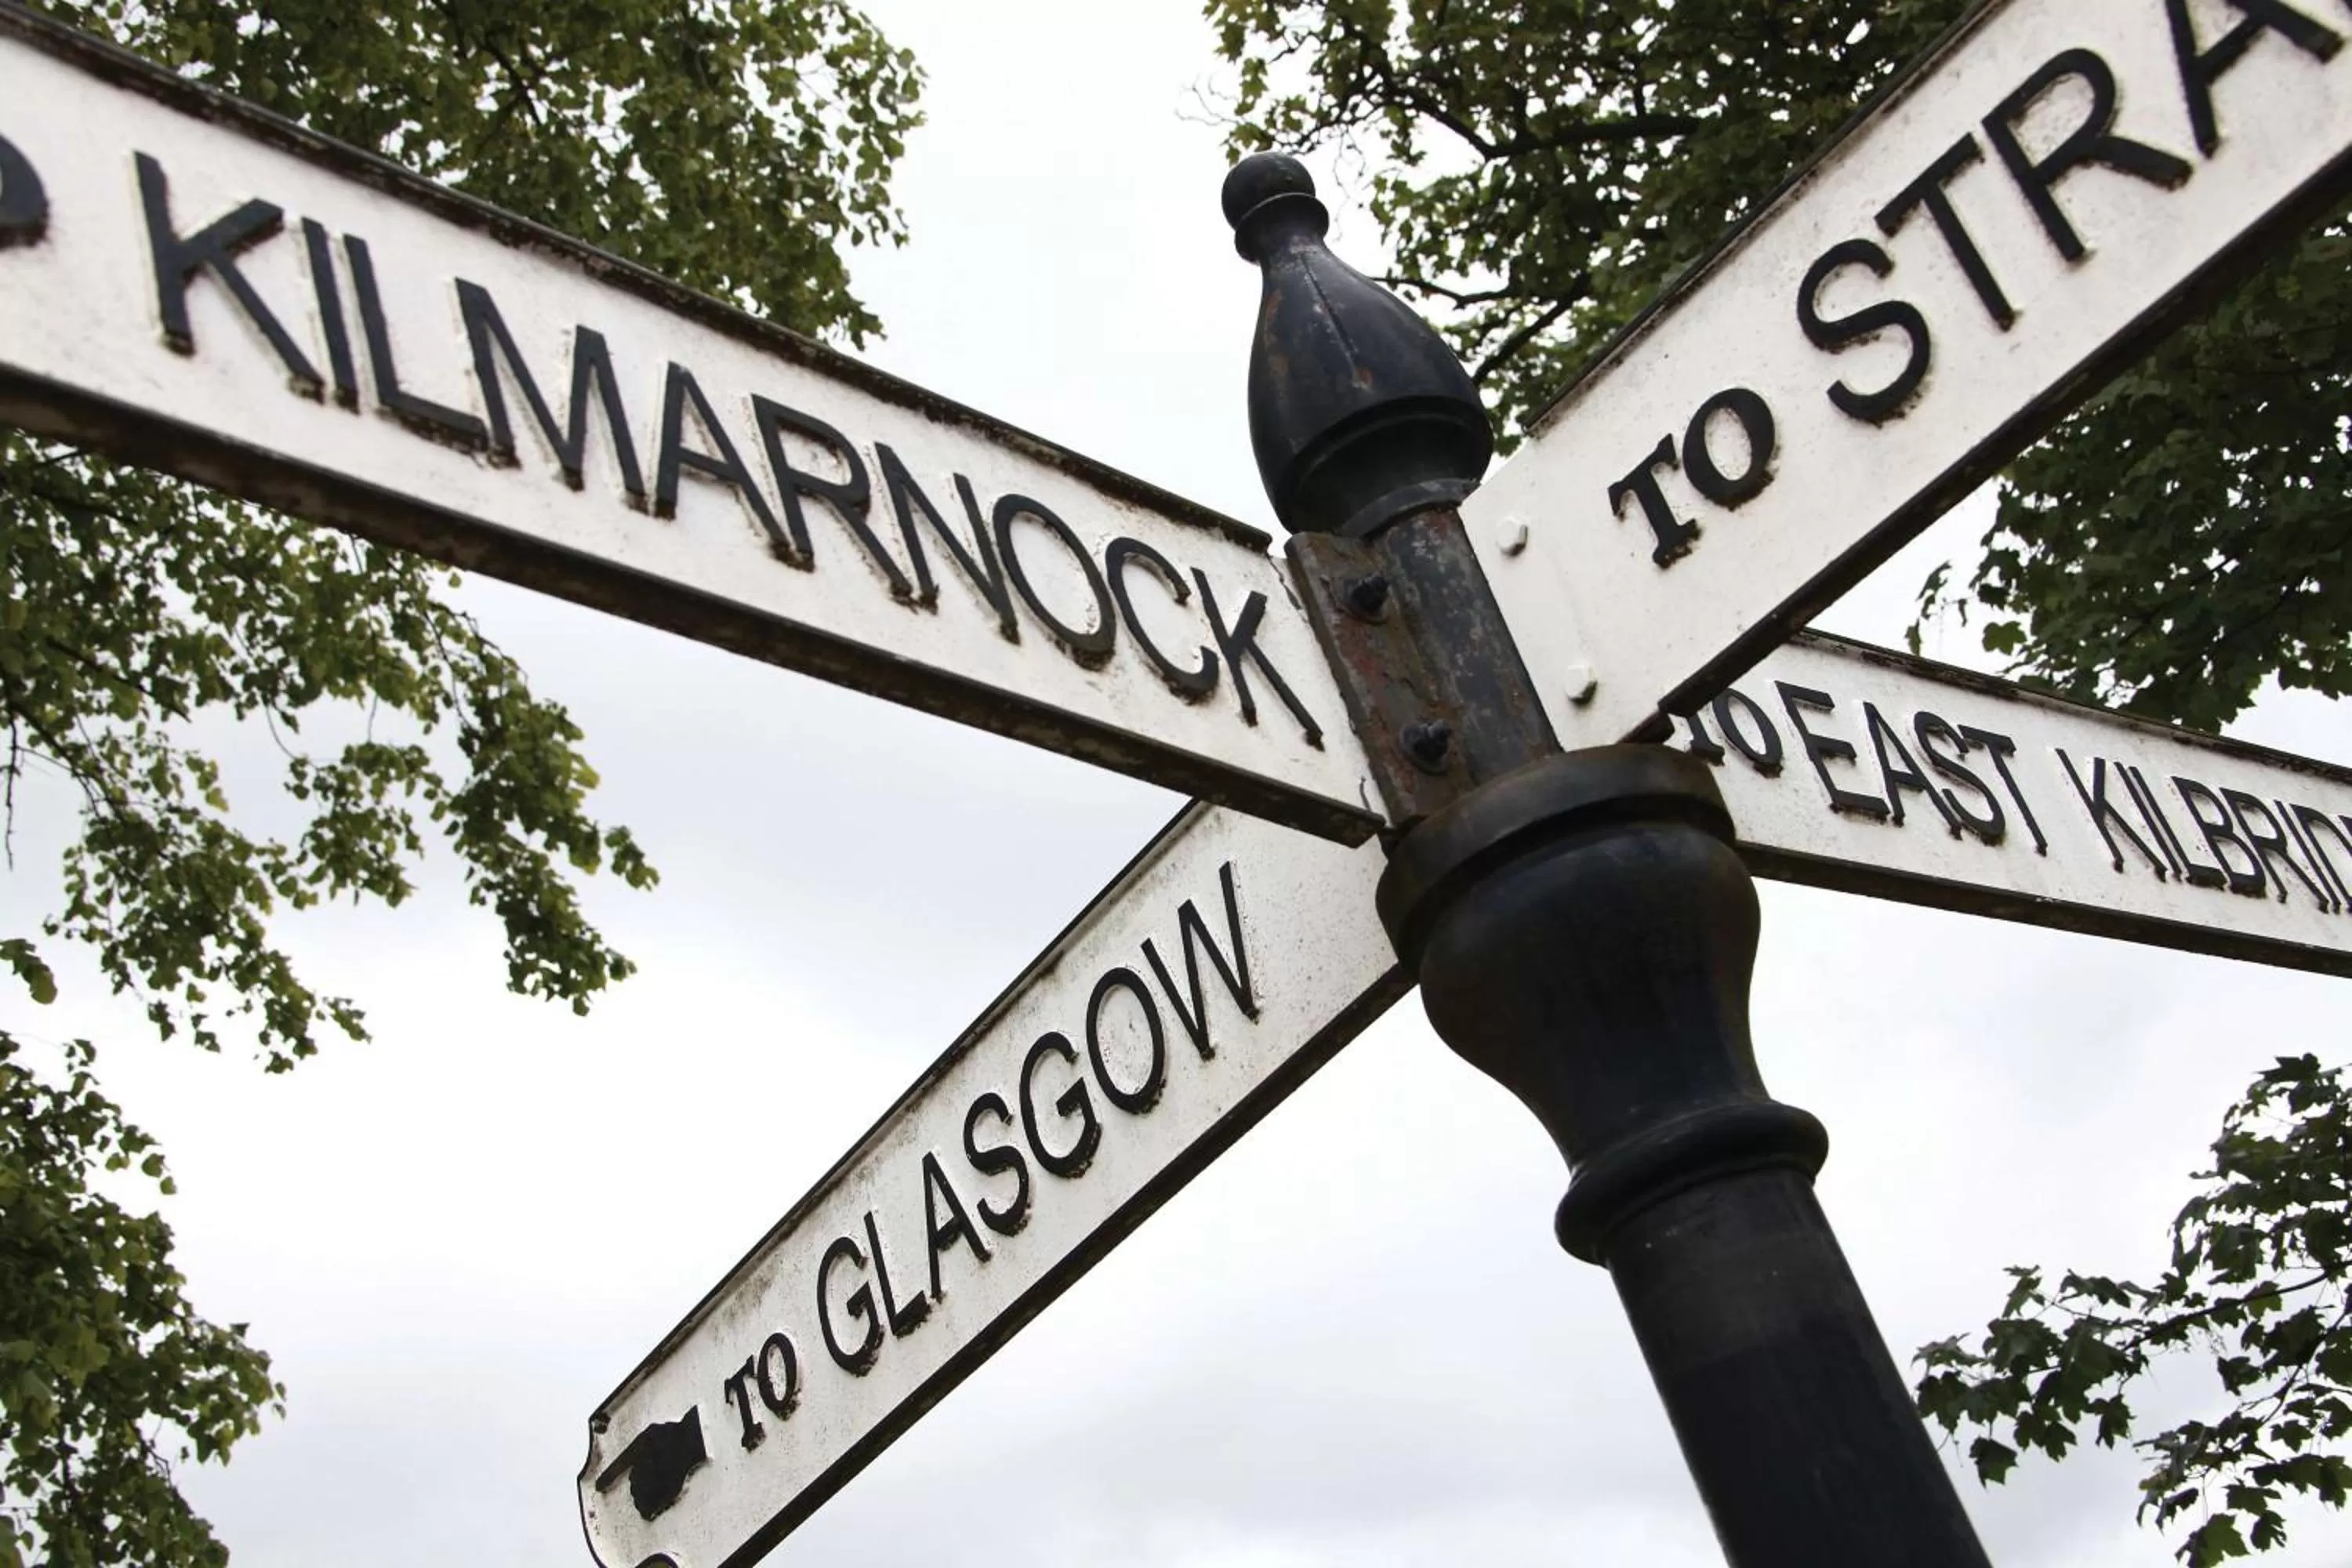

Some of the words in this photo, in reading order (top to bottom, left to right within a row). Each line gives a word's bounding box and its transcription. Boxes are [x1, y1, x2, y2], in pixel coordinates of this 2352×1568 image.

[132, 149, 1325, 752] KILMARNOCK
[1607, 387, 1779, 569] TO
[1796, 0, 2352, 427] STRA
[1774, 680, 2049, 857] EAST
[2055, 748, 2352, 915] KILBRID
[724, 1331, 801, 1453] TO
[816, 861, 1260, 1377] GLASGOW
